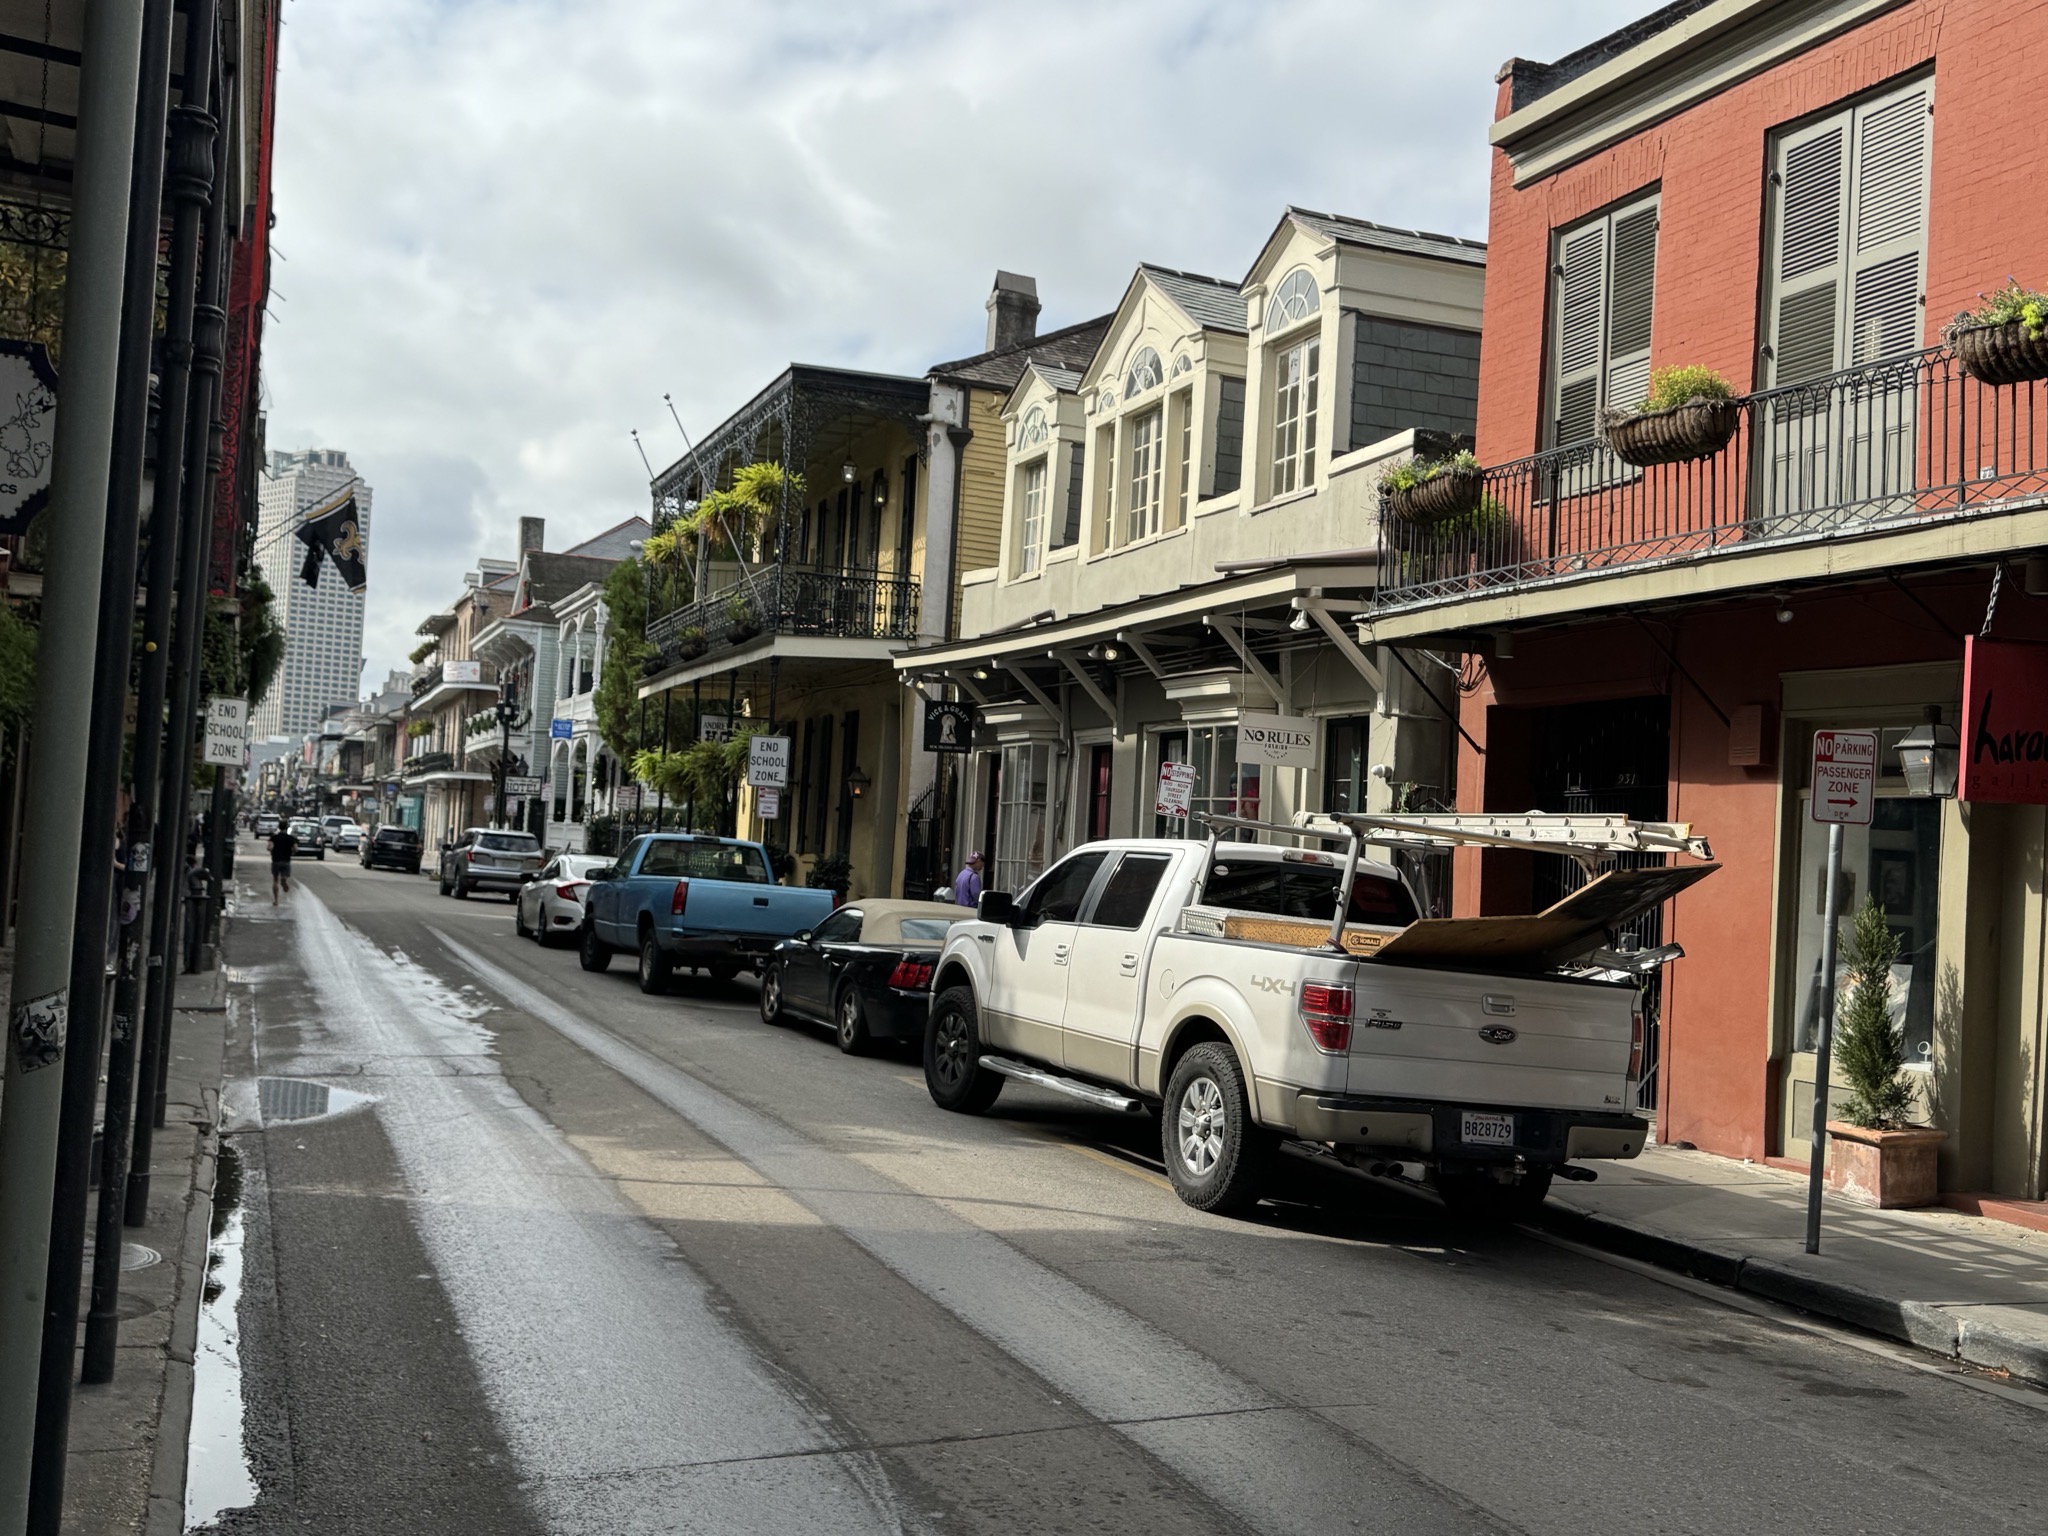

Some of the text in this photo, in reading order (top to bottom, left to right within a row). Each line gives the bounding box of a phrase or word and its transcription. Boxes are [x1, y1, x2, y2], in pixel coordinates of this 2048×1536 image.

[218, 704, 237, 718] END
[928, 706, 943, 720] VICE
[207, 722, 244, 740] SCHOOL
[1244, 729, 1311, 747] NO RULES
[212, 743, 237, 759] ZONE
[760, 742, 778, 752] END
[1816, 737, 1872, 757] NO PARKING
[750, 756, 787, 767] SCHOOL
[755, 770, 780, 781] ZONE
[1162, 766, 1193, 779] NO STOPPING
[1617, 773, 1636, 784] 931
[1817, 766, 1871, 779] PASSENGER
[505, 782, 540, 793] HOTEL
[1828, 781, 1859, 793] ZONE
[1163, 797, 1183, 805] CLEANING
[1360, 937, 1380, 945] KOBALT
[1493, 1030, 1512, 1039] Ford
[1464, 1121, 1512, 1139] B828729
